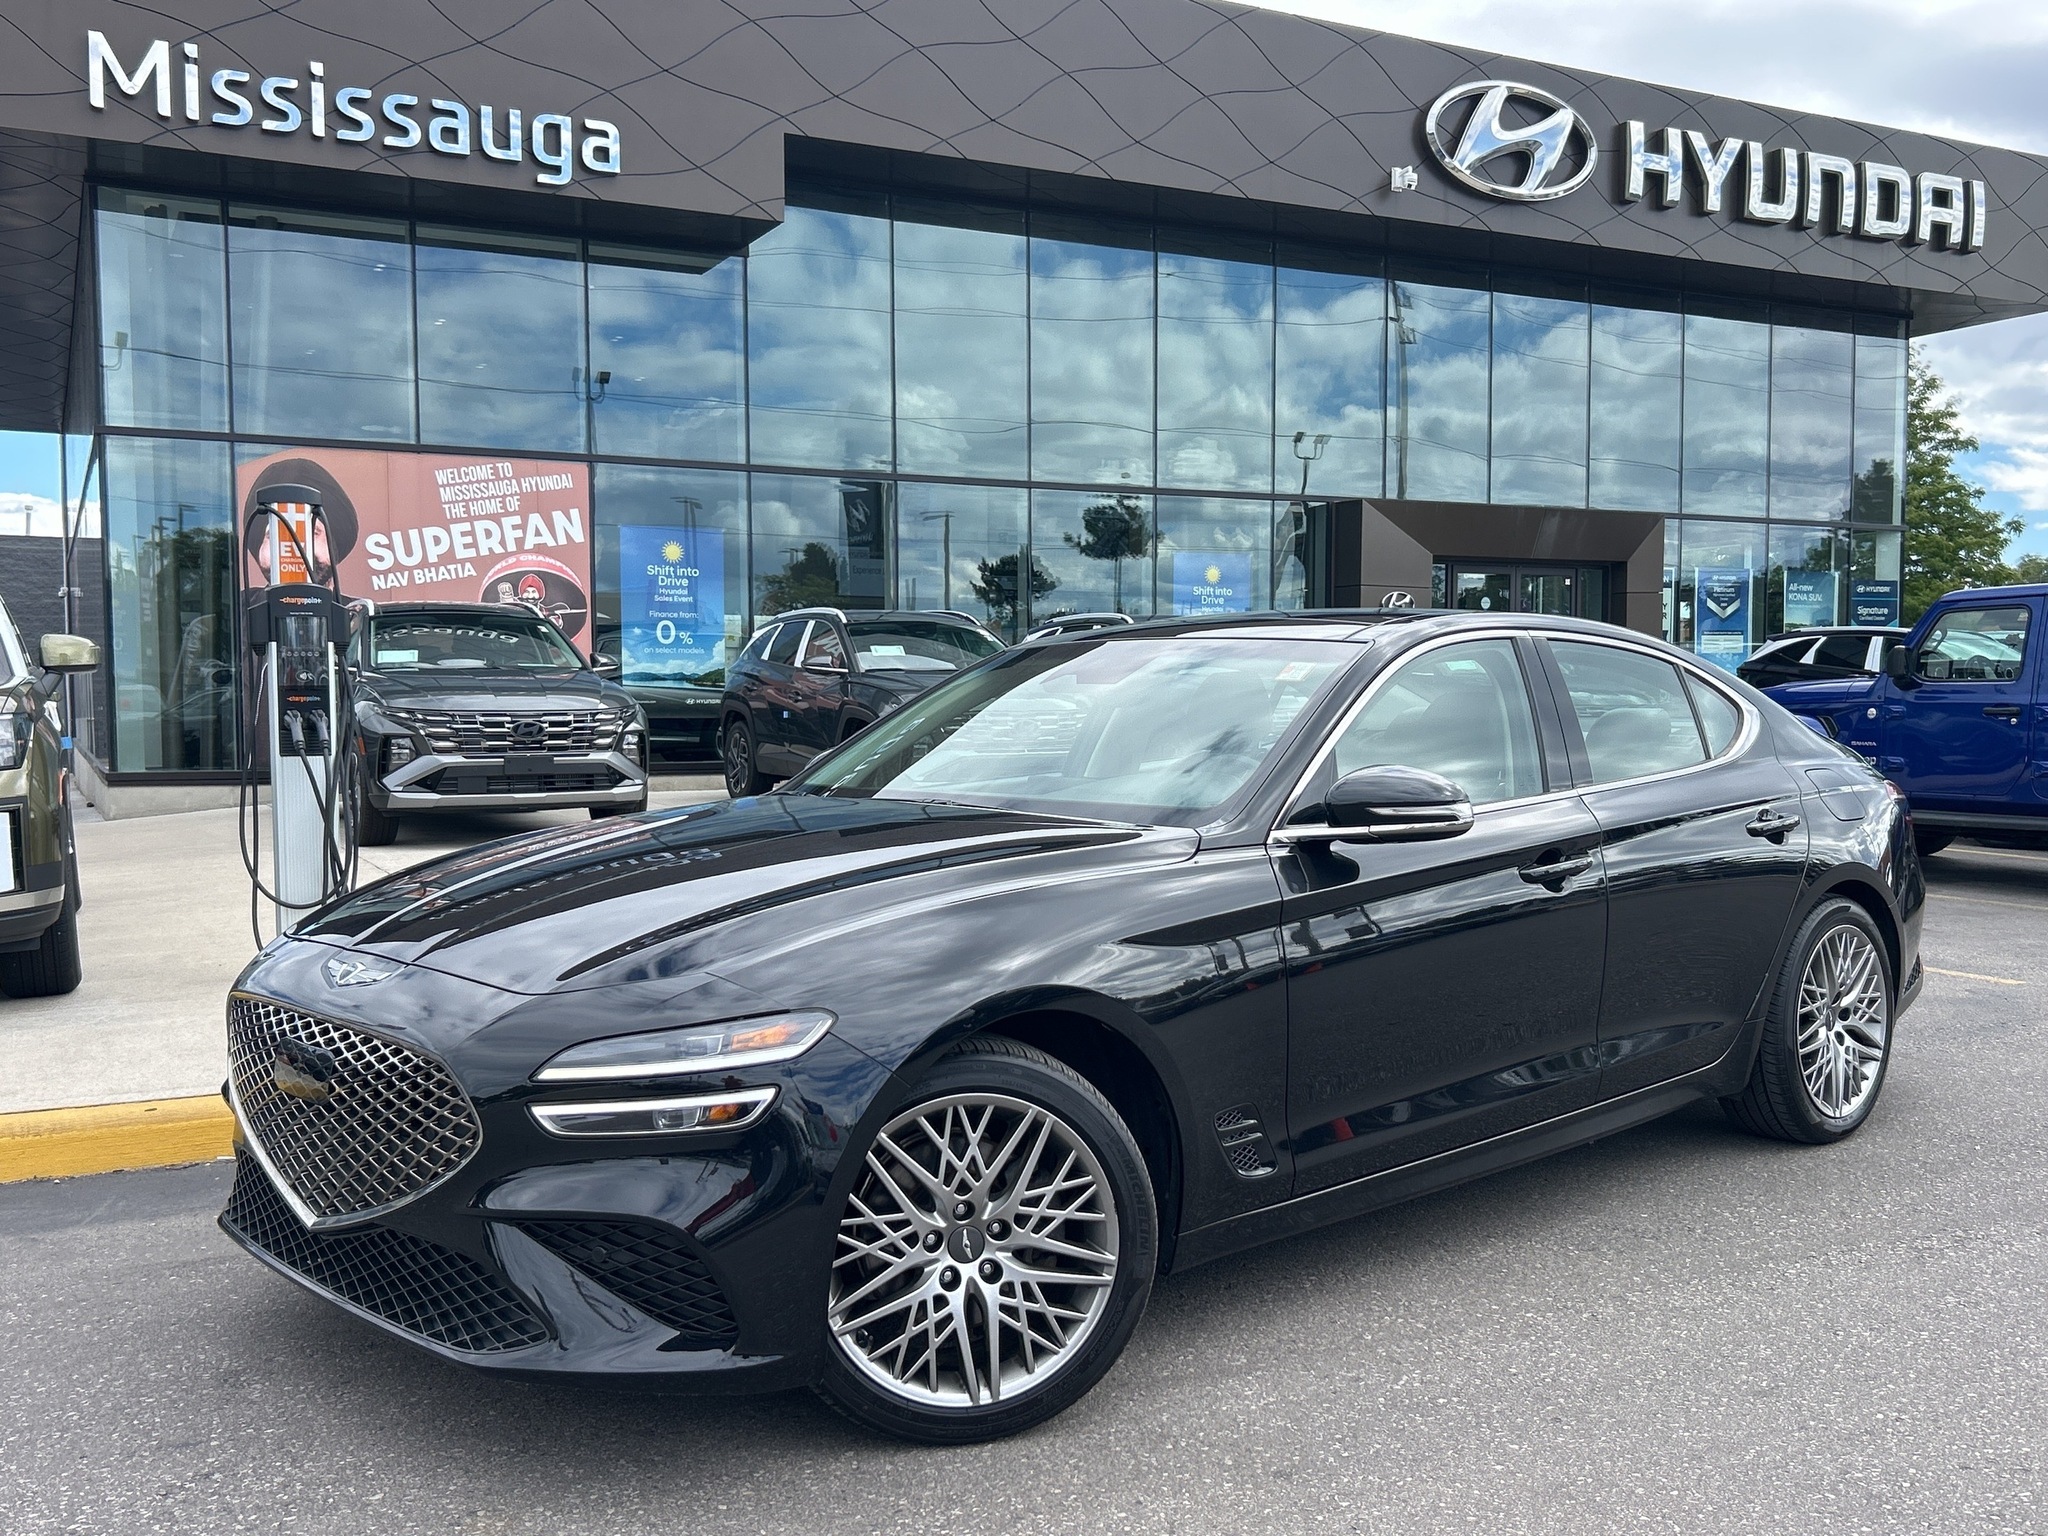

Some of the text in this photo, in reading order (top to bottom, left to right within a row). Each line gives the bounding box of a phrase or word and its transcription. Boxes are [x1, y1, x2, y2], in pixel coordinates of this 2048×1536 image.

[87, 30, 622, 186] Mississauga
[1622, 119, 1985, 253] HYUNDAI
[435, 461, 513, 486] WELCOME TO
[440, 472, 573, 503] MISSISSAUGA HYUNDAI
[443, 496, 521, 519] THE HOME OF
[364, 508, 585, 571] SUPERFAN
[280, 541, 305, 557] EV
[280, 564, 305, 572] ONLY
[647, 565, 699, 577] Shift into
[371, 560, 478, 591] NAV BHATIA
[658, 576, 689, 586] Drive
[1193, 586, 1233, 596] Shift into
[1788, 583, 1814, 591] All-new
[1201, 596, 1224, 604] Drive
[1788, 593, 1822, 602] KONA SUV.
[649, 610, 679, 618] Finance
[1857, 606, 1889, 616] Signature
[656, 619, 694, 645] 0 %
[655, 646, 677, 654] select
[678, 646, 705, 654] models
